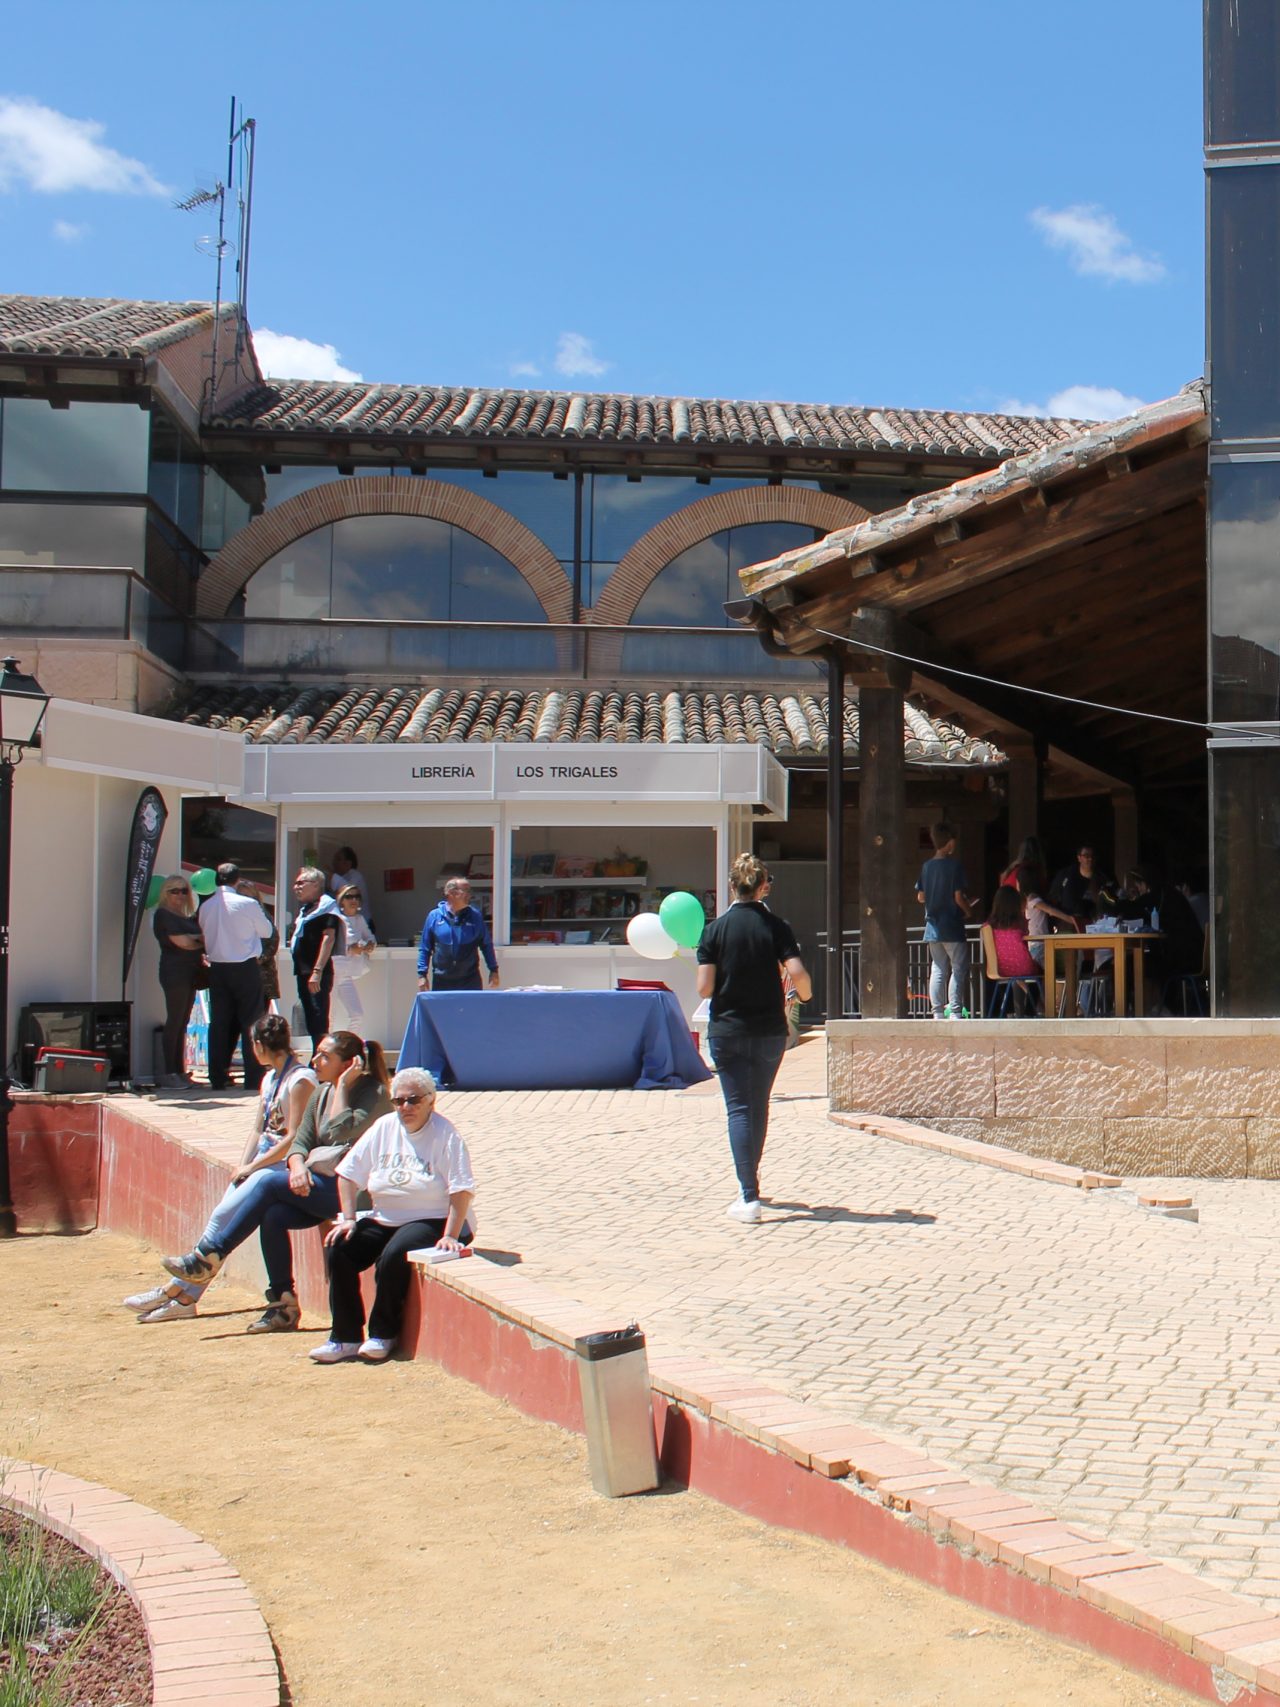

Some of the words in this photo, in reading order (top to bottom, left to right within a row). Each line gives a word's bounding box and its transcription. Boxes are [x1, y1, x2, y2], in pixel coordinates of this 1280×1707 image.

[411, 763, 476, 779] LIBRERÍA
[516, 766, 544, 778] LOS
[549, 766, 619, 778] TRIGALES
